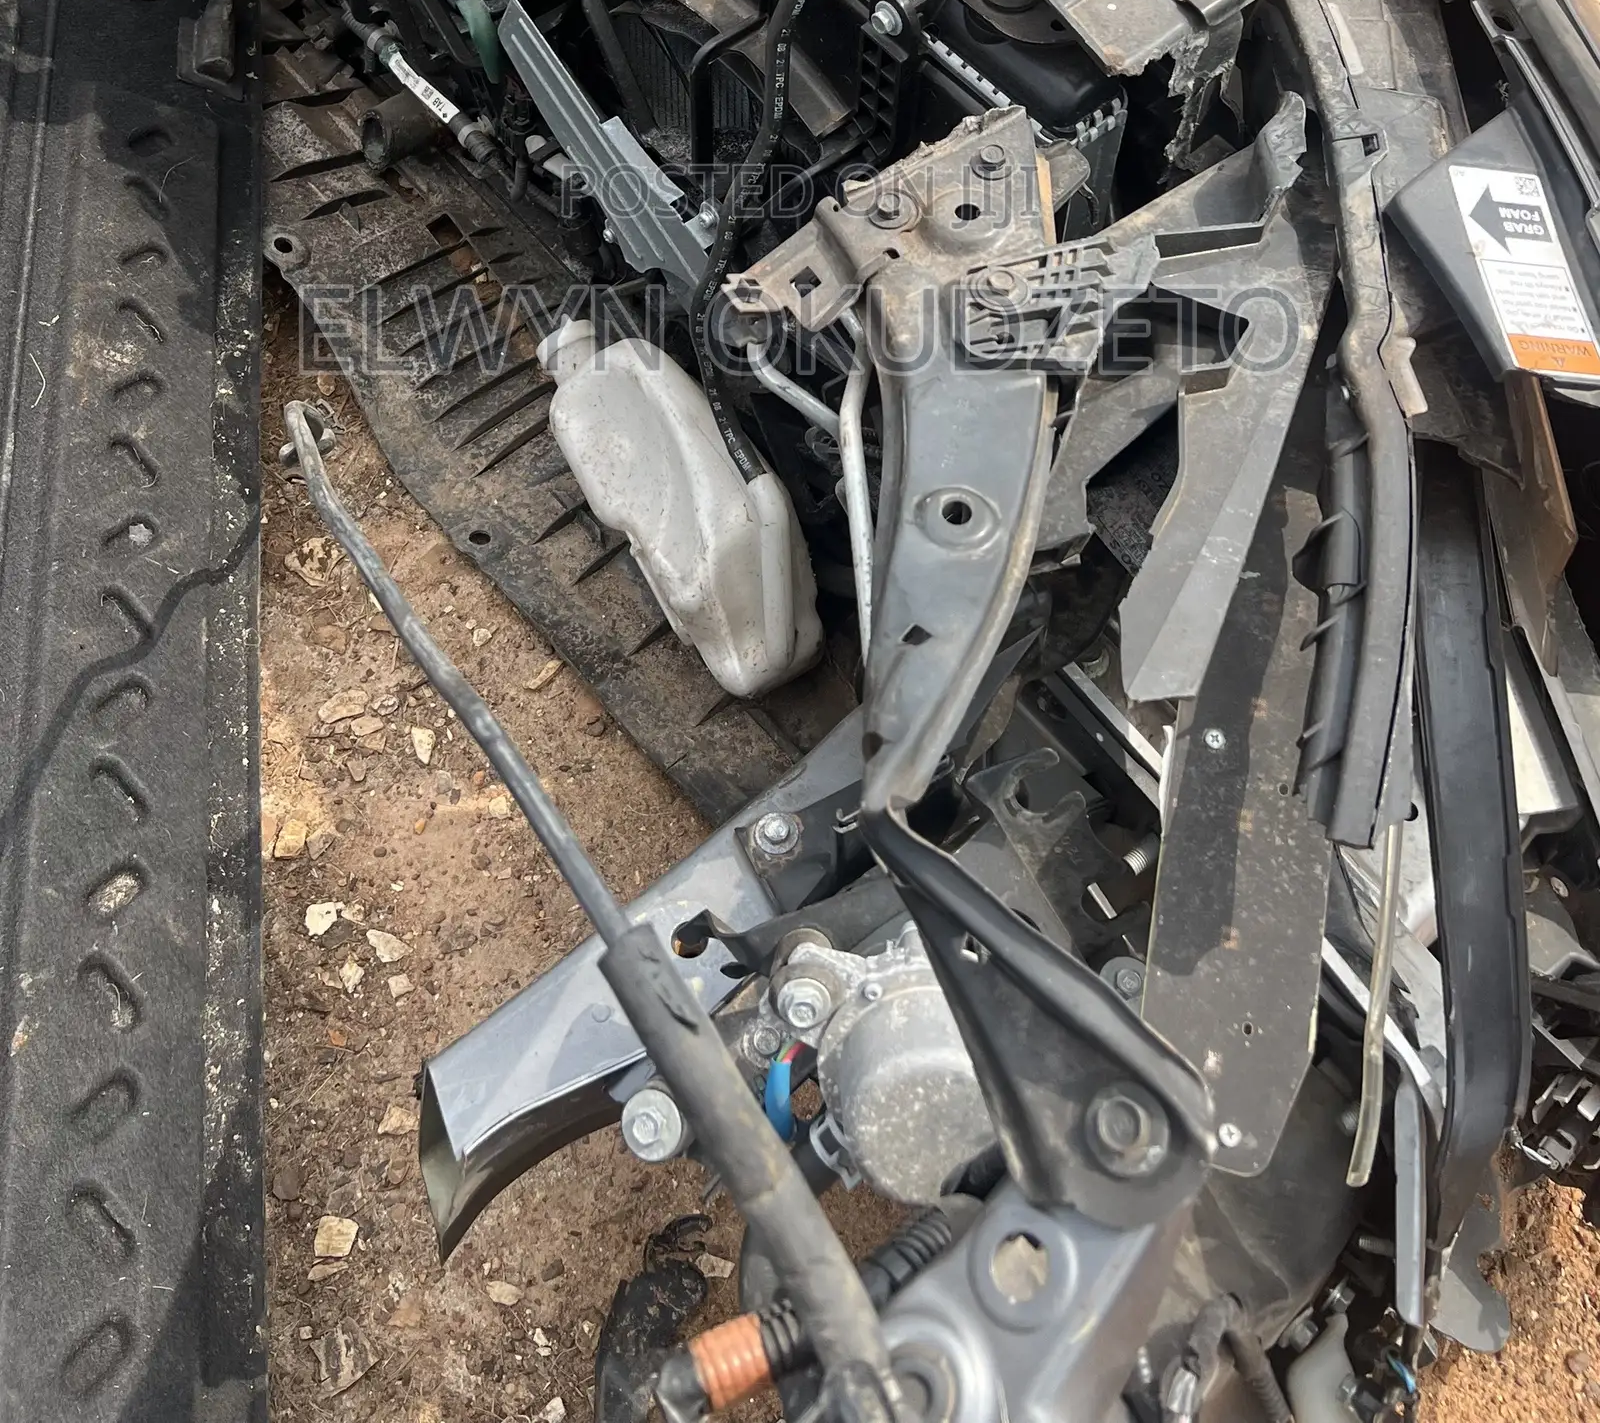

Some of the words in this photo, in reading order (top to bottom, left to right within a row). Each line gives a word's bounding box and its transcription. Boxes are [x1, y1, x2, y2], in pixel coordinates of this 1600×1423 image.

[432, 97, 446, 113] TAB
[1498, 206, 1541, 221] FOAM
[1503, 221, 1545, 236] GRAB
[1518, 340, 1592, 357] WARNING
[723, 427, 736, 445] TPC
[733, 448, 753, 472] EPDM
